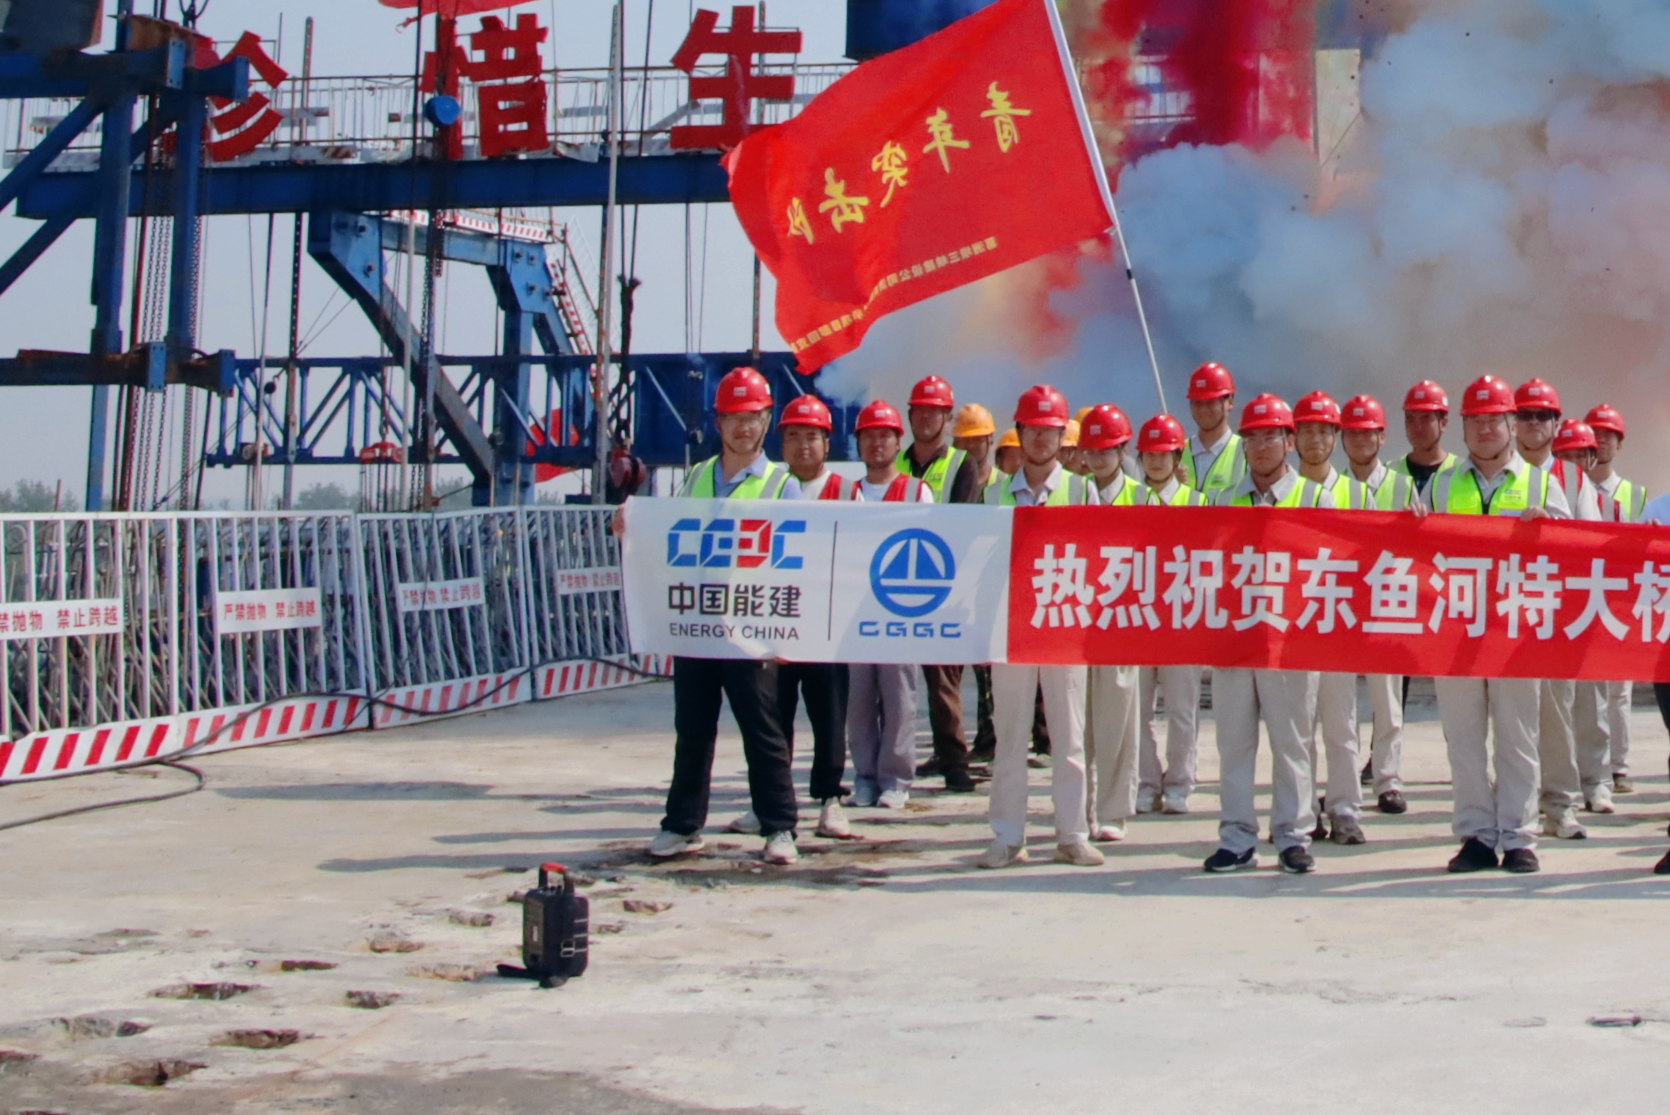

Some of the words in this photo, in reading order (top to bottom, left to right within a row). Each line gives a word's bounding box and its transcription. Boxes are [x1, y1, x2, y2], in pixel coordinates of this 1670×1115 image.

[223, 602, 267, 621] 严禁抛物
[275, 599, 317, 619] 禁止跨越
[668, 583, 802, 619] 中国能建
[57, 605, 119, 630] 禁止跨越
[669, 622, 736, 639] ENERGY
[741, 625, 800, 641] CHINA
[858, 620, 962, 639] CGGC
